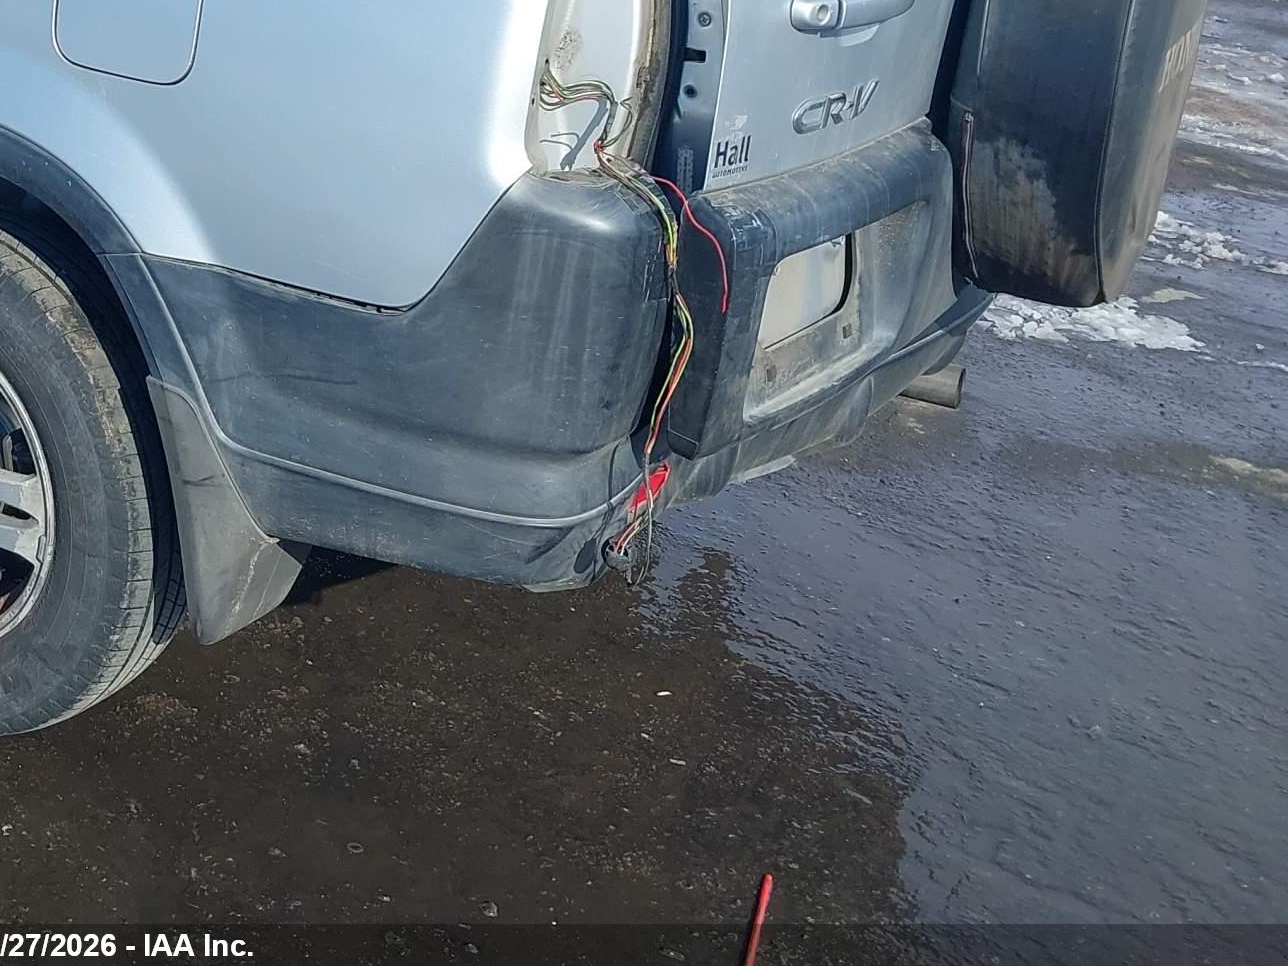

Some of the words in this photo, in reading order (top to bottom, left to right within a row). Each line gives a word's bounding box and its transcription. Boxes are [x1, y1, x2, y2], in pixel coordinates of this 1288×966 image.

[792, 77, 880, 135] CR-V
[713, 135, 752, 168] Hall
[712, 166, 748, 178] AUTOMOTIVE
